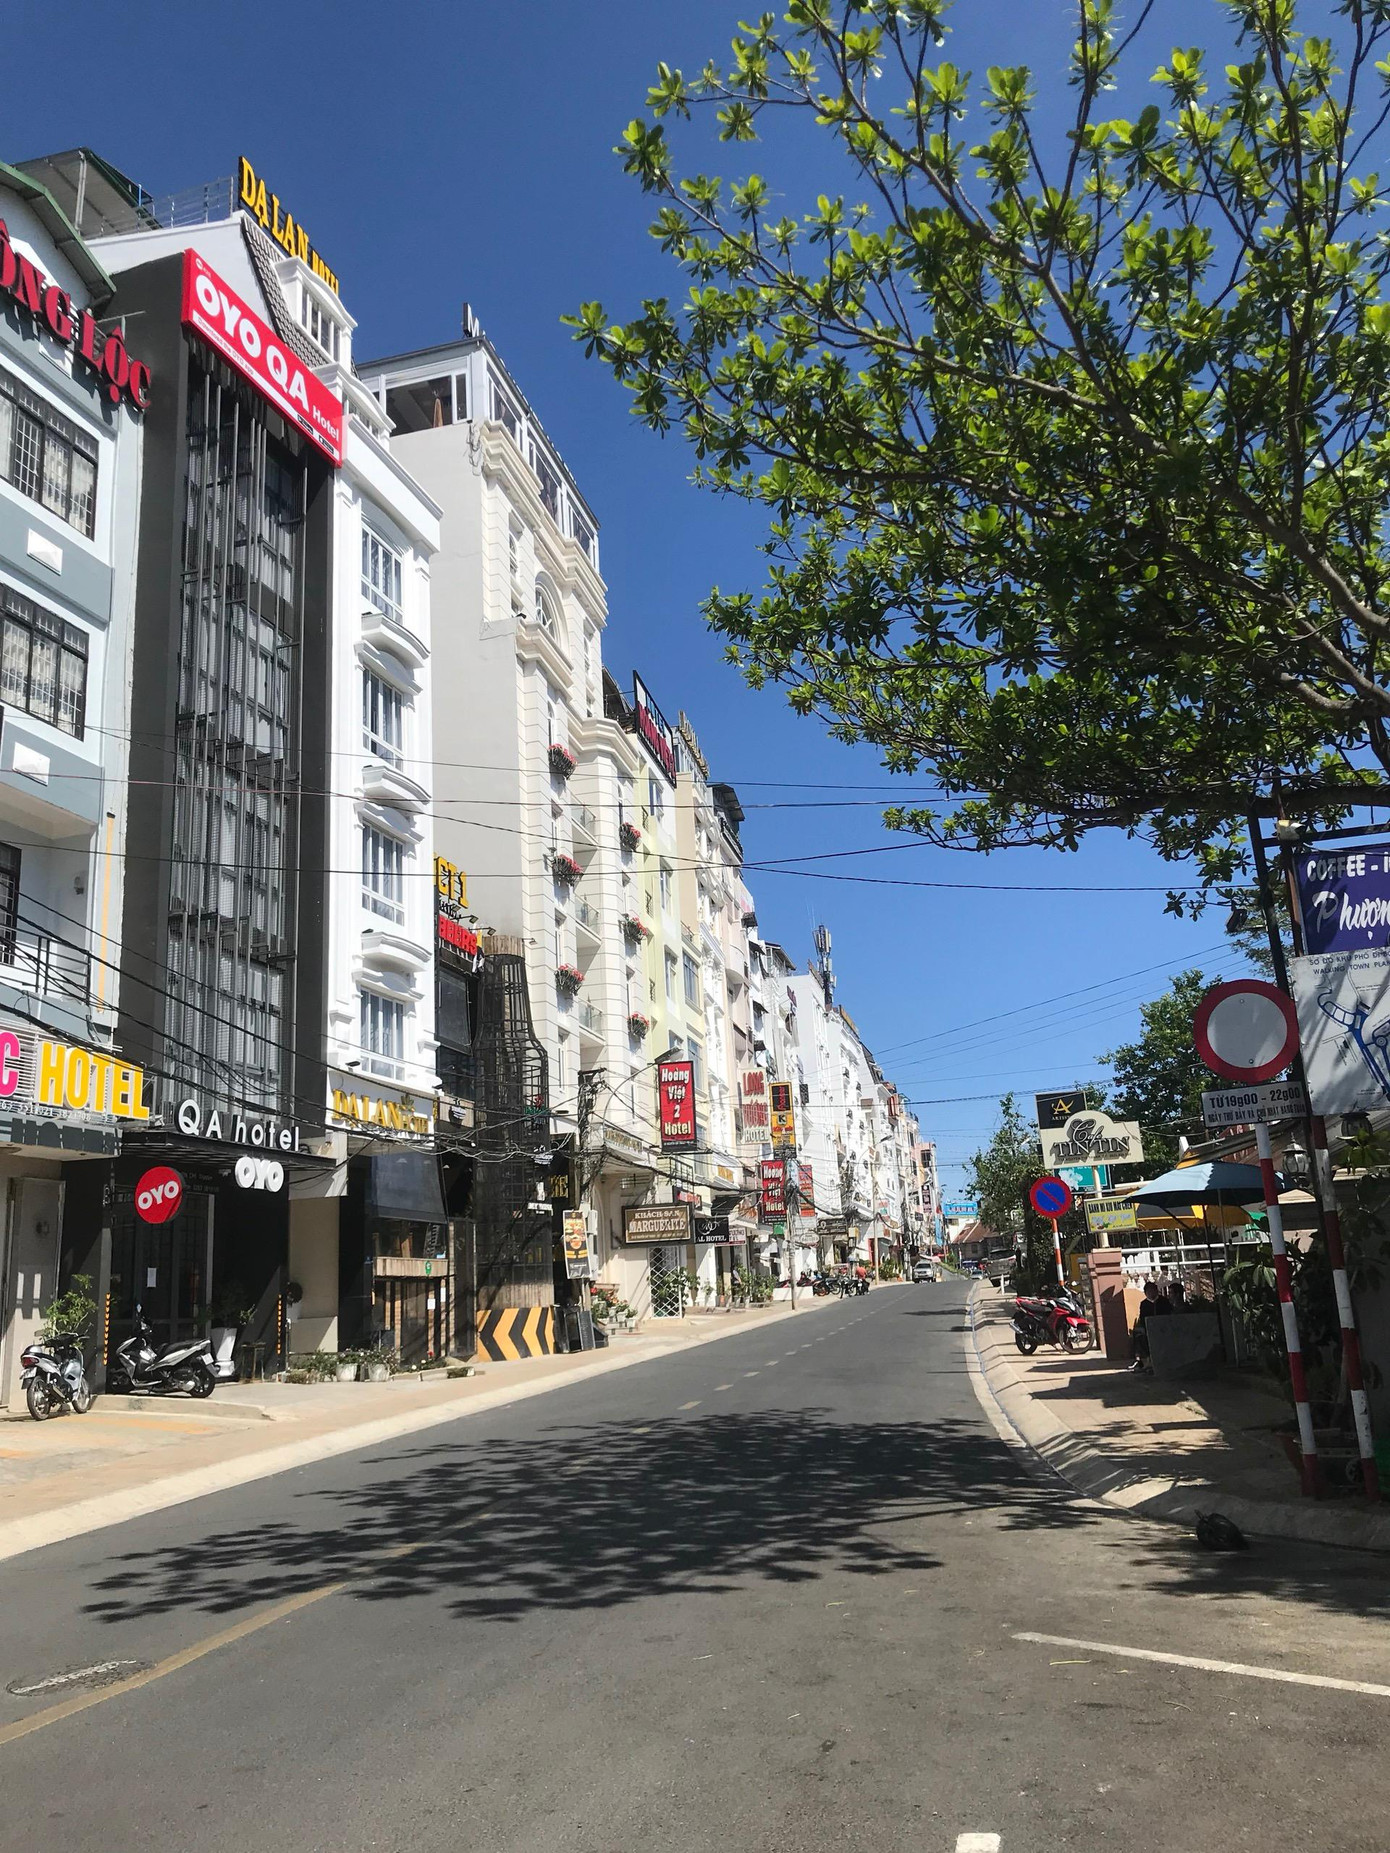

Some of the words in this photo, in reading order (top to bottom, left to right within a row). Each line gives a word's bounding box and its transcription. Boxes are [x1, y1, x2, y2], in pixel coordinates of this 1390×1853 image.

[272, 193, 309, 264] LAN
[80, 309, 151, 409] LỘC
[195, 274, 262, 359] OYO
[266, 344, 310, 414] QA
[312, 404, 339, 442] Hotel
[1307, 854, 1366, 881] COFFEE
[438, 914, 477, 956] BEERS
[1313, 965, 1345, 975] WALKING
[1350, 962, 1370, 970] TOWN
[39, 1041, 150, 1120] HOTEL
[661, 1067, 690, 1083] Hoàng
[1269, 1087, 1300, 1101] 22g00
[178, 1100, 222, 1139] QA
[235, 1115, 300, 1152] hotel
[674, 1104, 681, 1118] 2
[664, 1121, 691, 1136] Hotel
[745, 1129, 770, 1142] HOTEL
[235, 1156, 285, 1193] OYO
[138, 1181, 180, 1211] OYO
